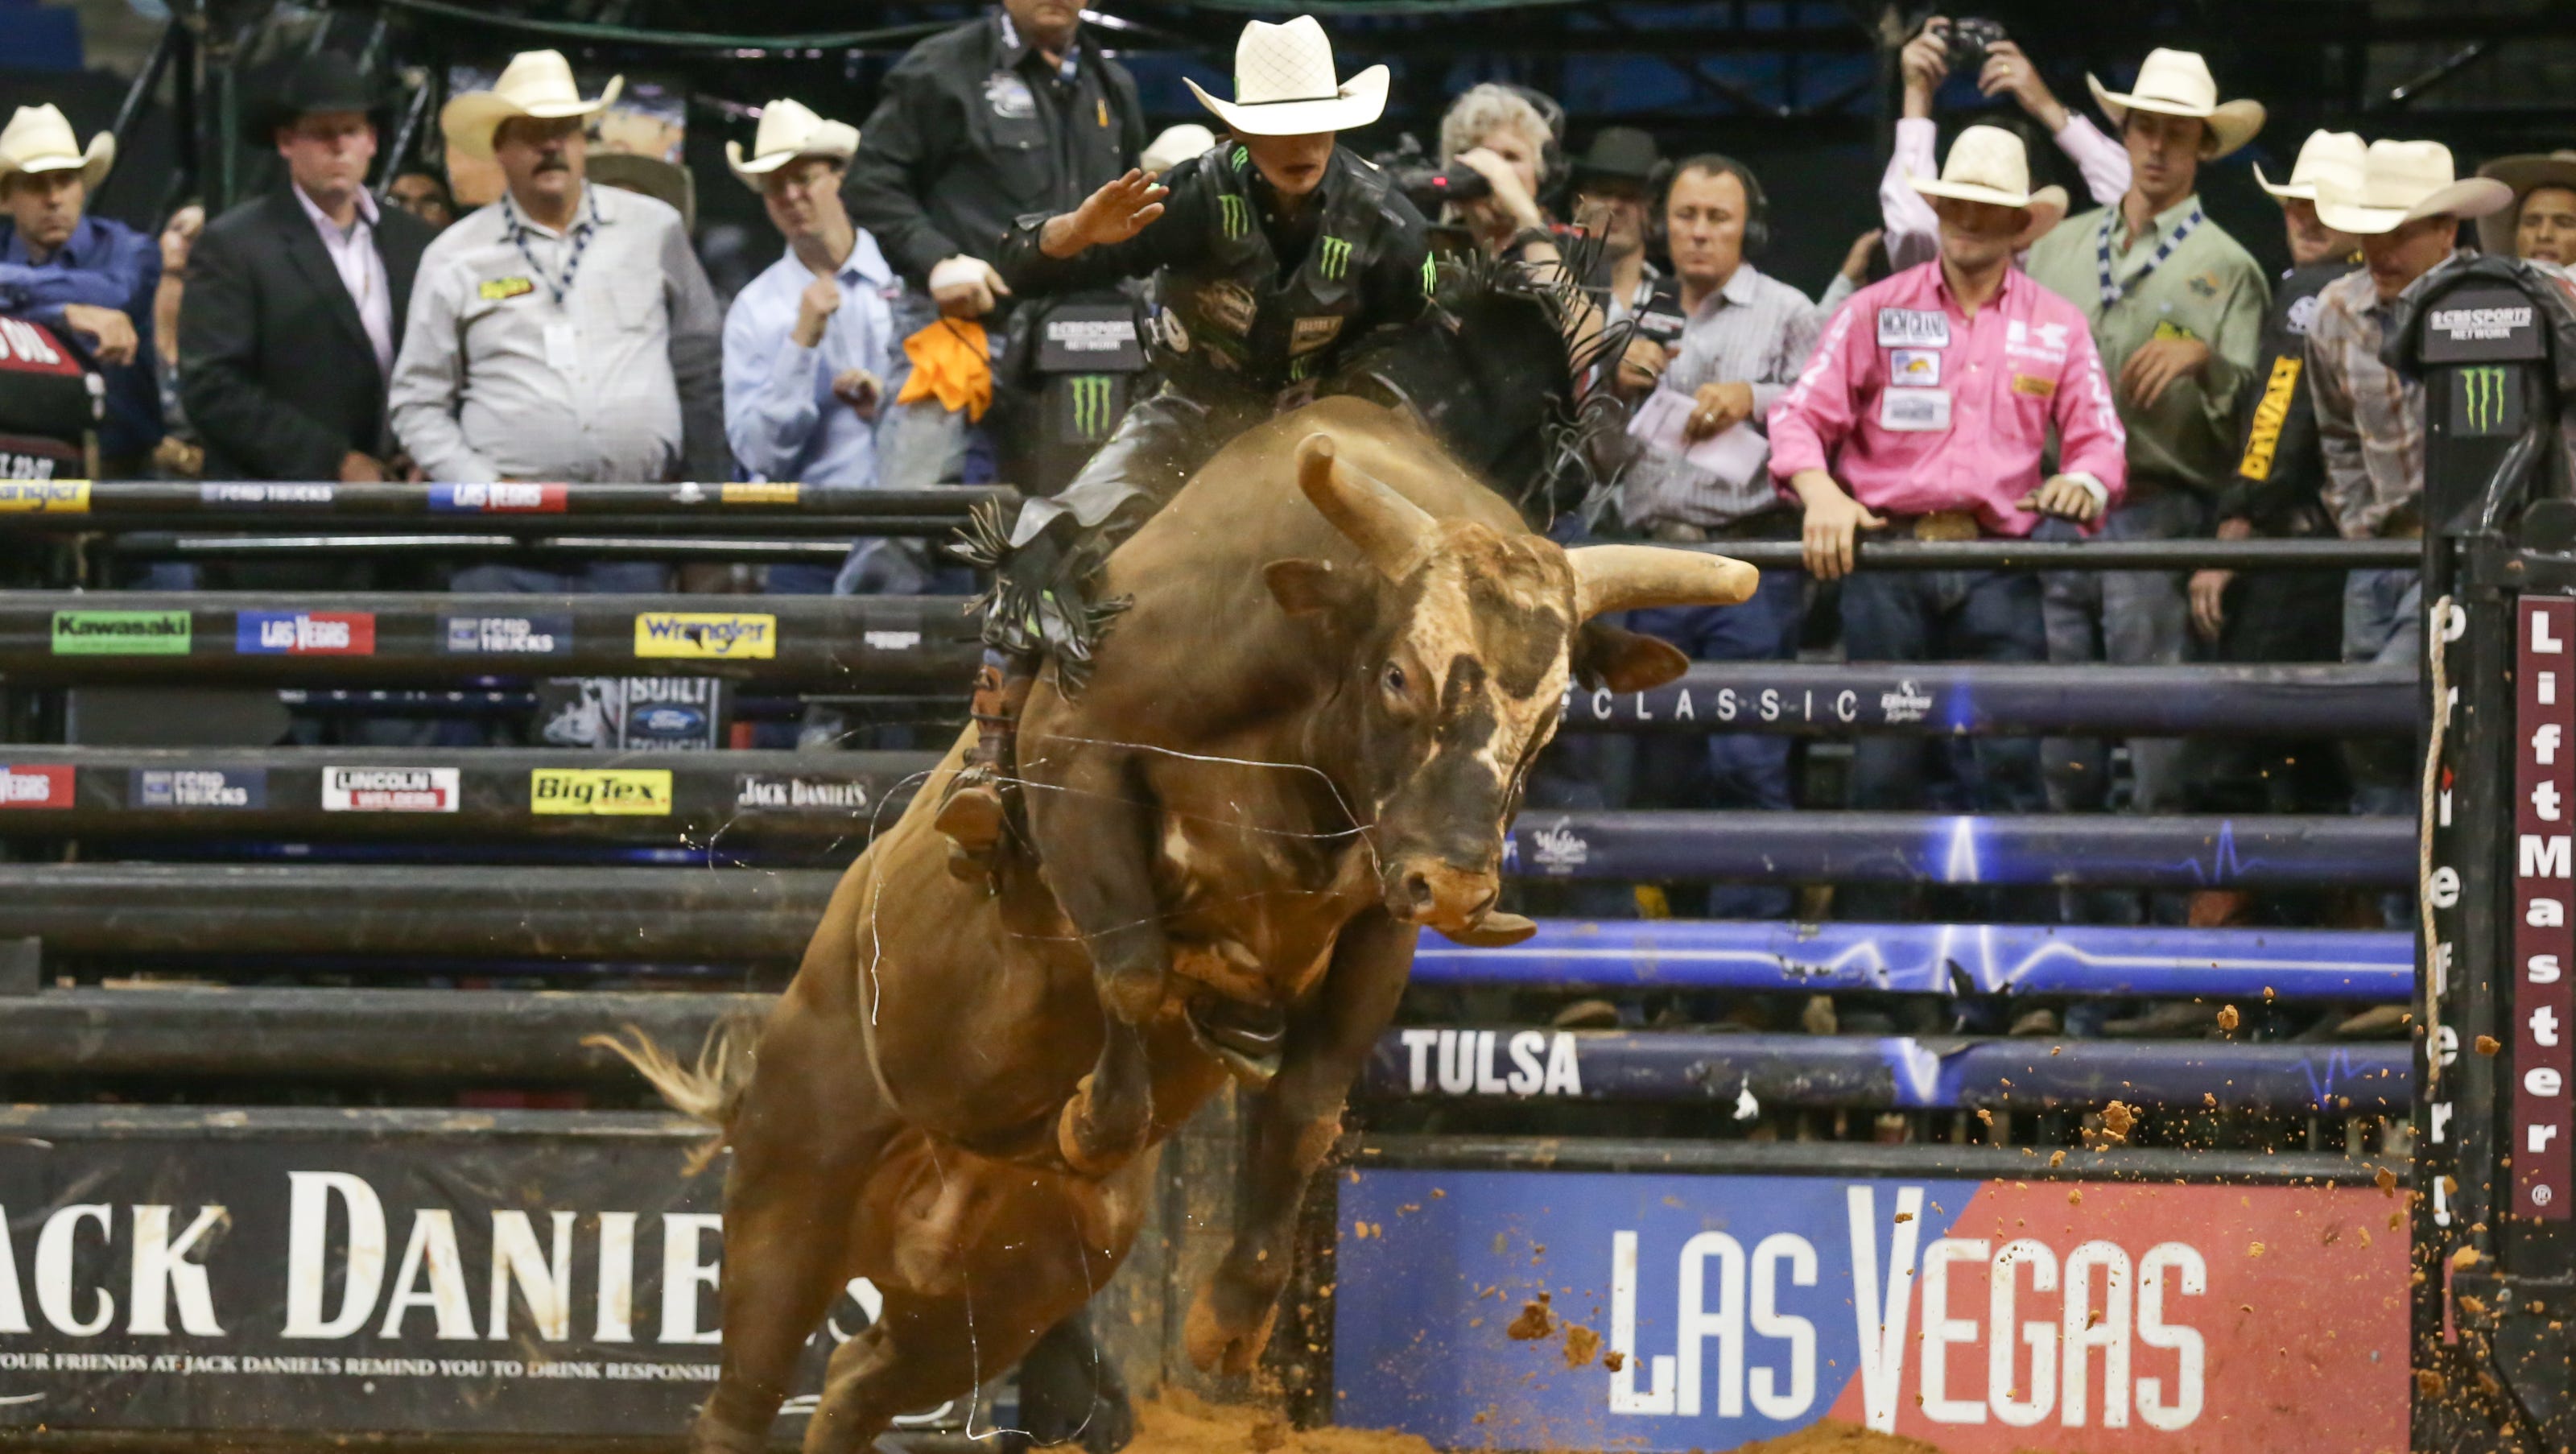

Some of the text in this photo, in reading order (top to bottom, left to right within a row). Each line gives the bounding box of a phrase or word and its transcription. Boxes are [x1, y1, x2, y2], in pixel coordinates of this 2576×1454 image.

[486, 483, 542, 510] VEGAS
[57, 616, 186, 636] Kawasaki
[261, 614, 350, 651] LAS VEGAS
[481, 618, 531, 634] FORD
[646, 618, 766, 655] Wrangler
[481, 634, 554, 652] TRUCKS
[630, 677, 707, 704] BUILT
[1591, 687, 1857, 722] CLASSIC
[174, 770, 225, 788] FORD
[336, 772, 431, 791] LINCOLN
[738, 777, 867, 806] JACK DANIEL'S
[175, 787, 247, 806] TRUCKS
[1401, 1029, 1582, 1095] TULSA
[0, 1202, 229, 1337] CK
[1609, 1185, 2207, 1435] LAS VEGAS
[0, 1353, 721, 1382] OUR FRIENDS AT JACK DANIEL'S REMIND YOU TO DRINK RESPONSI
